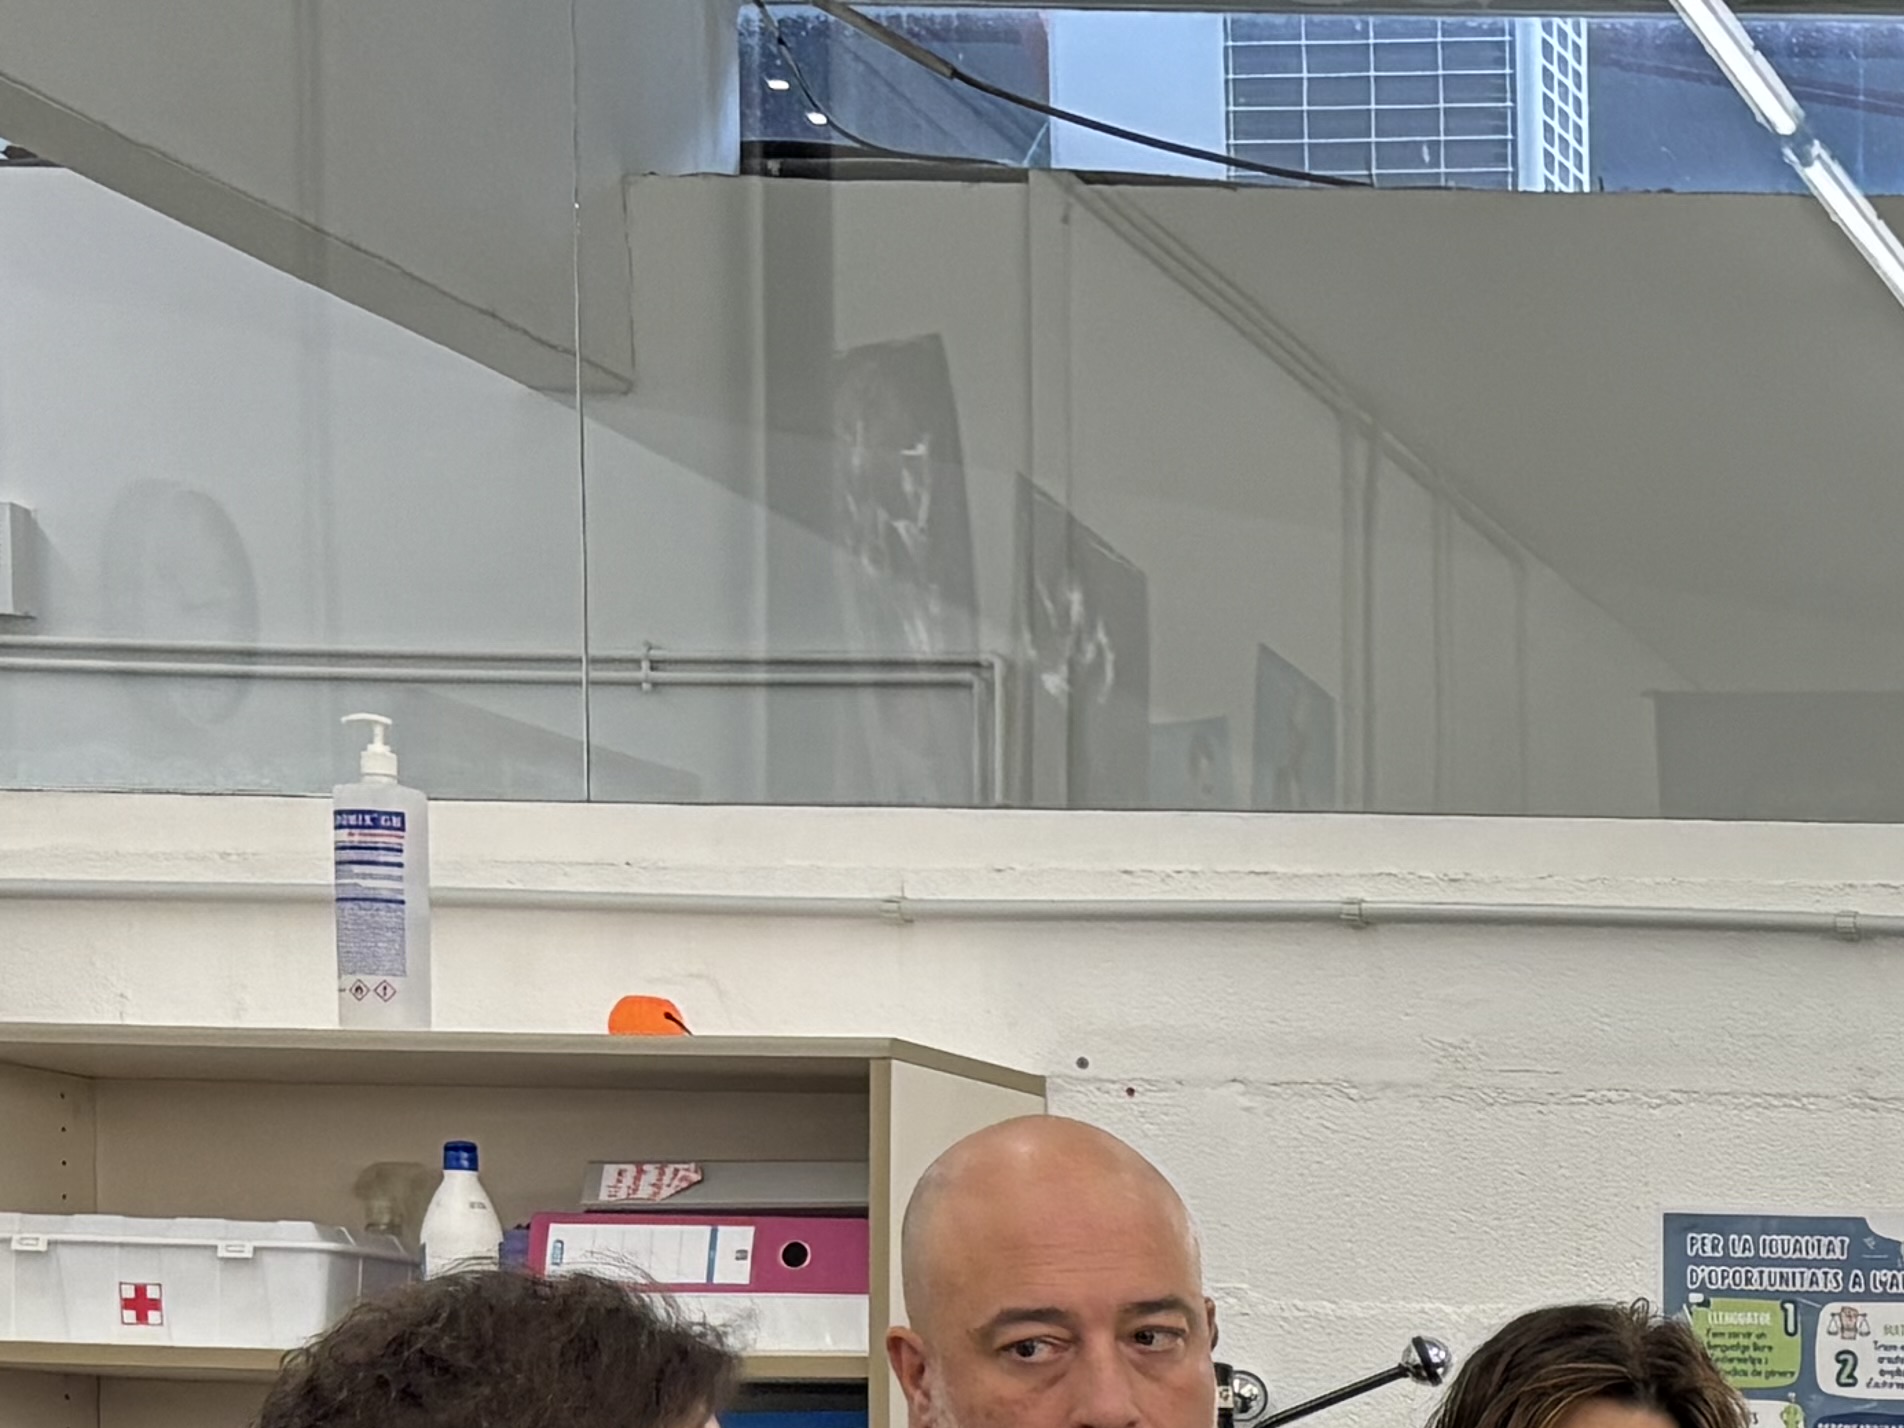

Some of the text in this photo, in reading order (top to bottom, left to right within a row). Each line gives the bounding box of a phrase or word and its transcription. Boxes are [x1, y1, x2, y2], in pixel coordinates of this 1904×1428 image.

[1687, 1233, 1849, 1260] PER LA IGUALTAT
[1687, 1265, 1842, 1292] D'OPORTUNITATS
[1850, 1269, 1865, 1293] A
[1780, 1301, 1798, 1337] 1
[1834, 1349, 1858, 1388] 2
